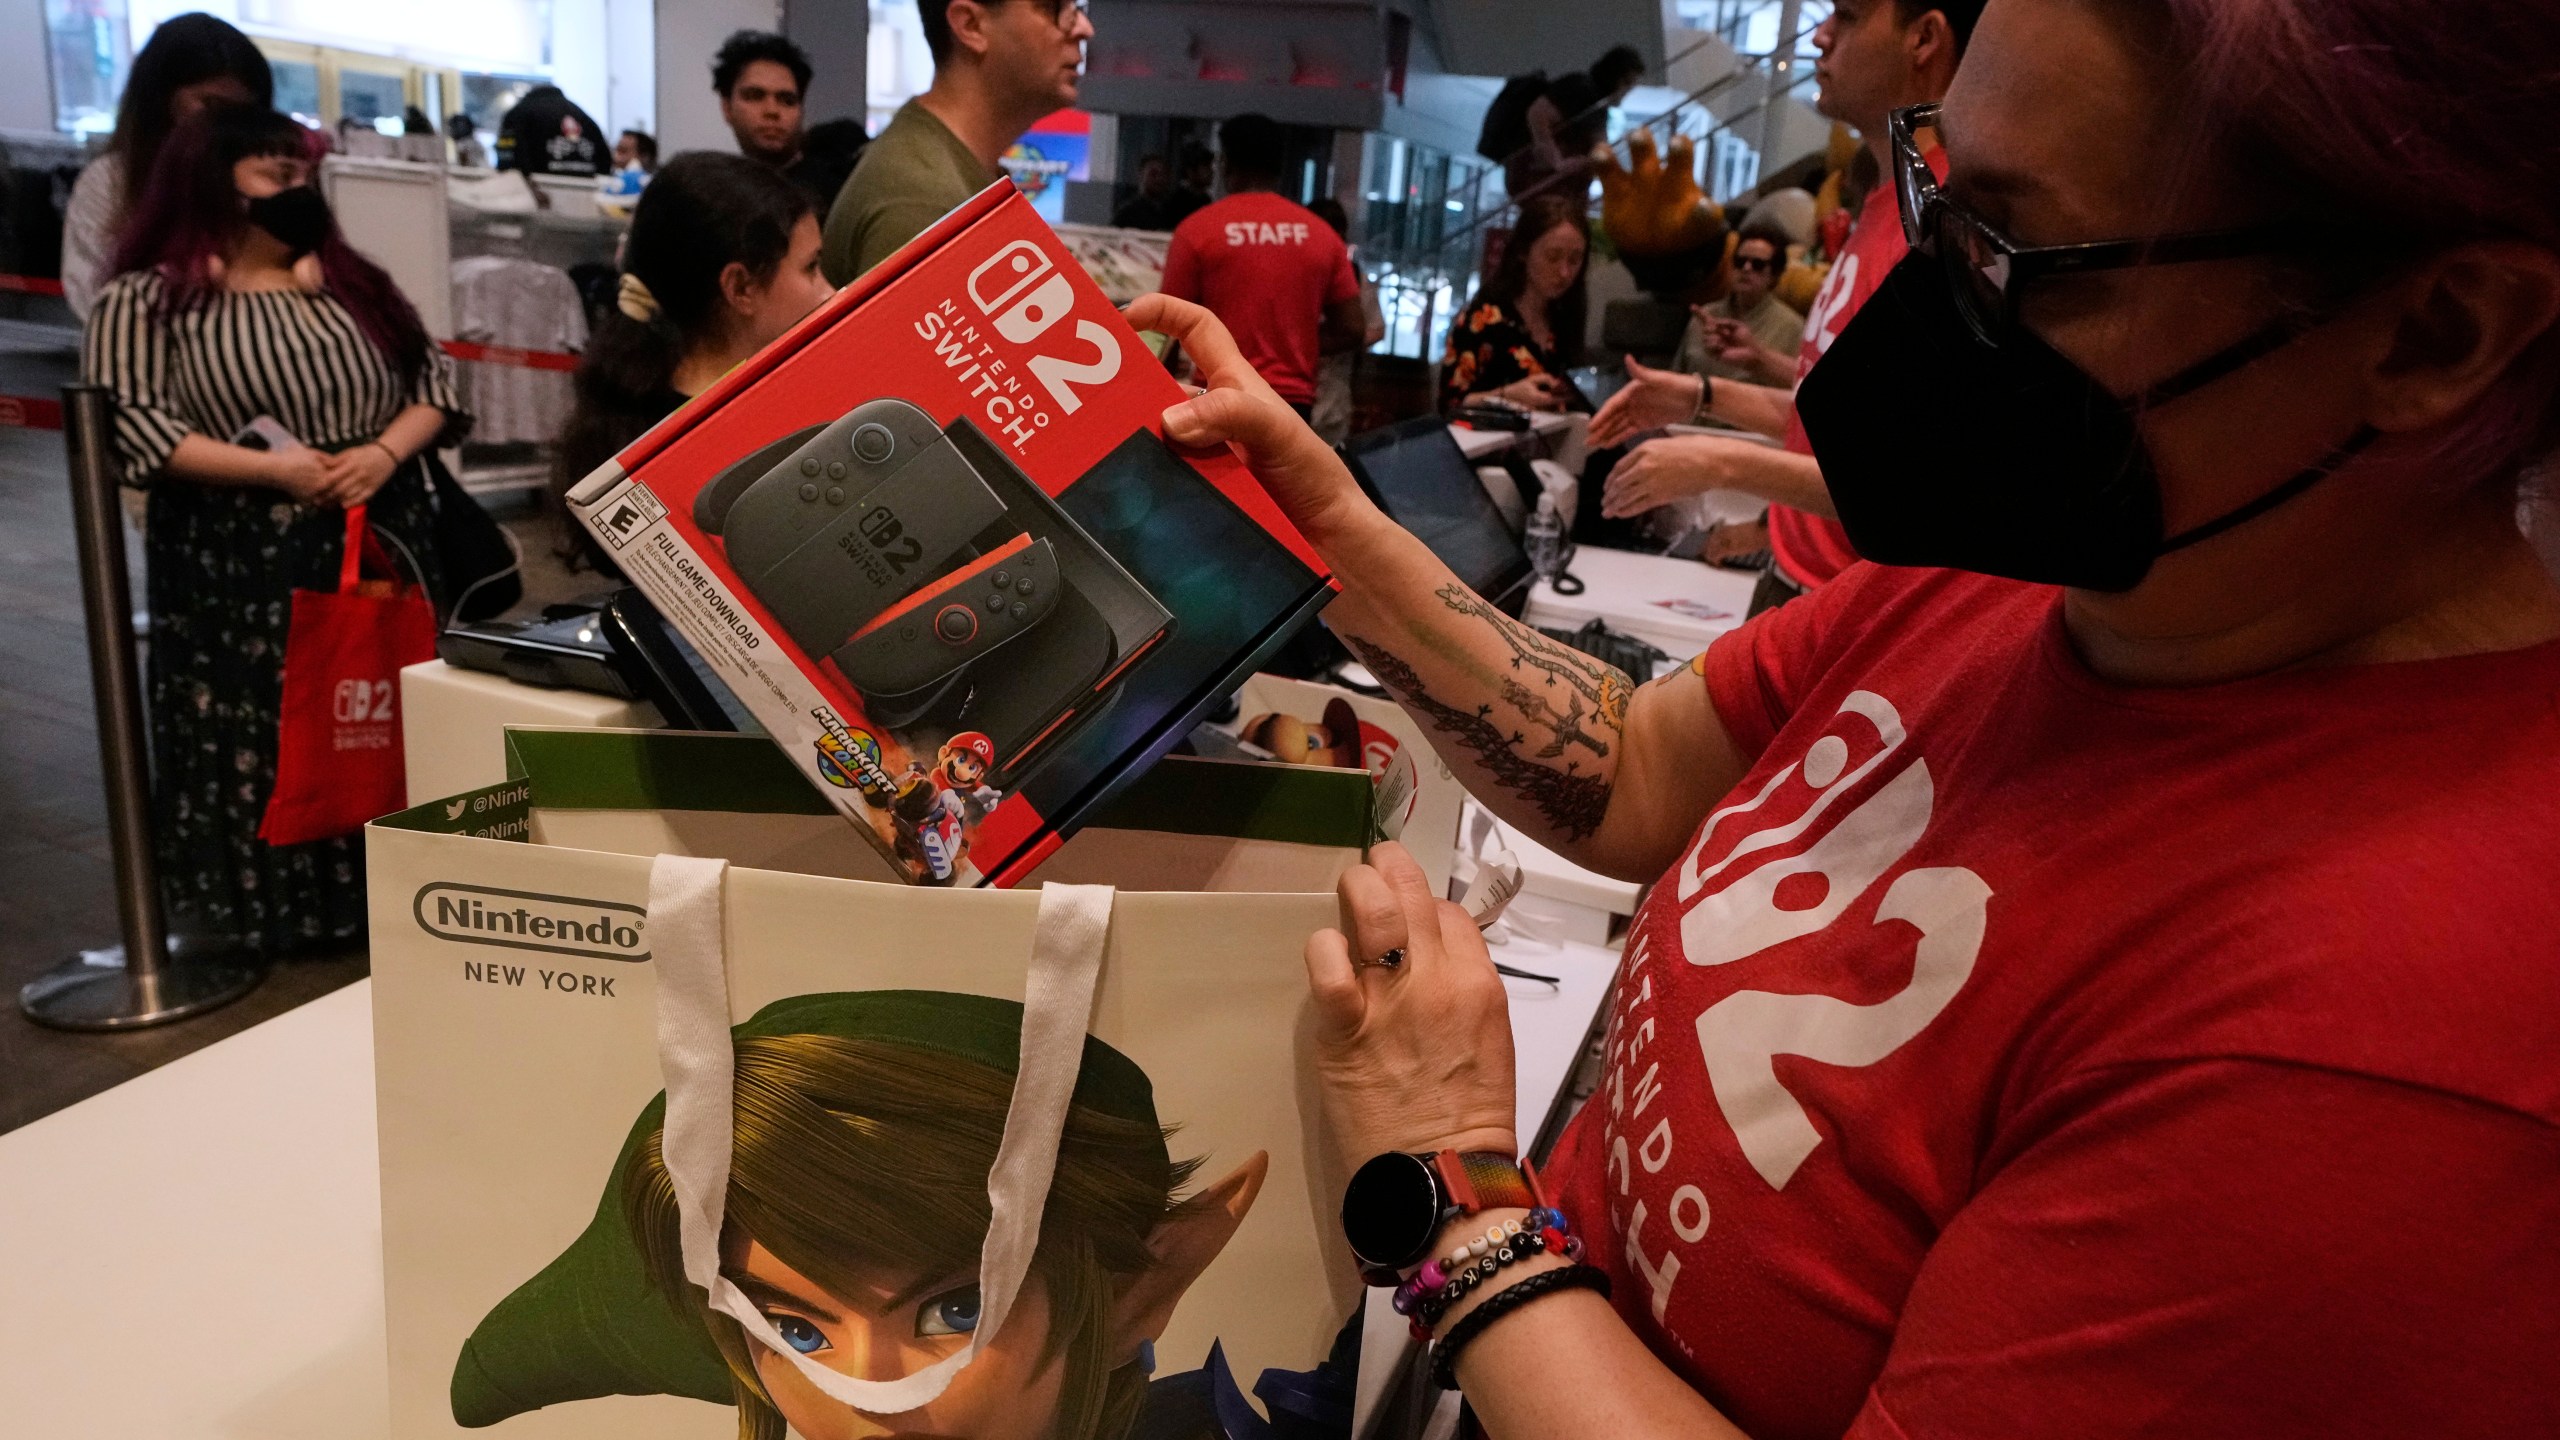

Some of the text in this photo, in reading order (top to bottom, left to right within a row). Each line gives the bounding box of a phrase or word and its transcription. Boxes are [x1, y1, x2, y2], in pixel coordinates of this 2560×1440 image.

[1224, 222, 1309, 246] STAFF
[938, 298, 1049, 428] NINTENDO
[1026, 319, 1122, 416] 2
[591, 515, 622, 549] ESRB
[609, 504, 640, 535] E
[652, 531, 760, 649] FULL GAME DOWNLOAD
[838, 536, 887, 589] SWITCH
[683, 587, 695, 599] DU
[690, 597, 704, 609] JEU
[700, 606, 726, 632] COMPLET
[724, 633, 752, 664] DESCARGA
[748, 659, 759, 671] DE
[754, 668, 774, 687] JUEGO
[770, 684, 798, 714] COMPLETO
[819, 733, 872, 785] WORLD
[464, 961, 616, 998] NEW YORK
[1694, 866, 1995, 1193] 2
[1628, 893, 1711, 1244] INTENDO
